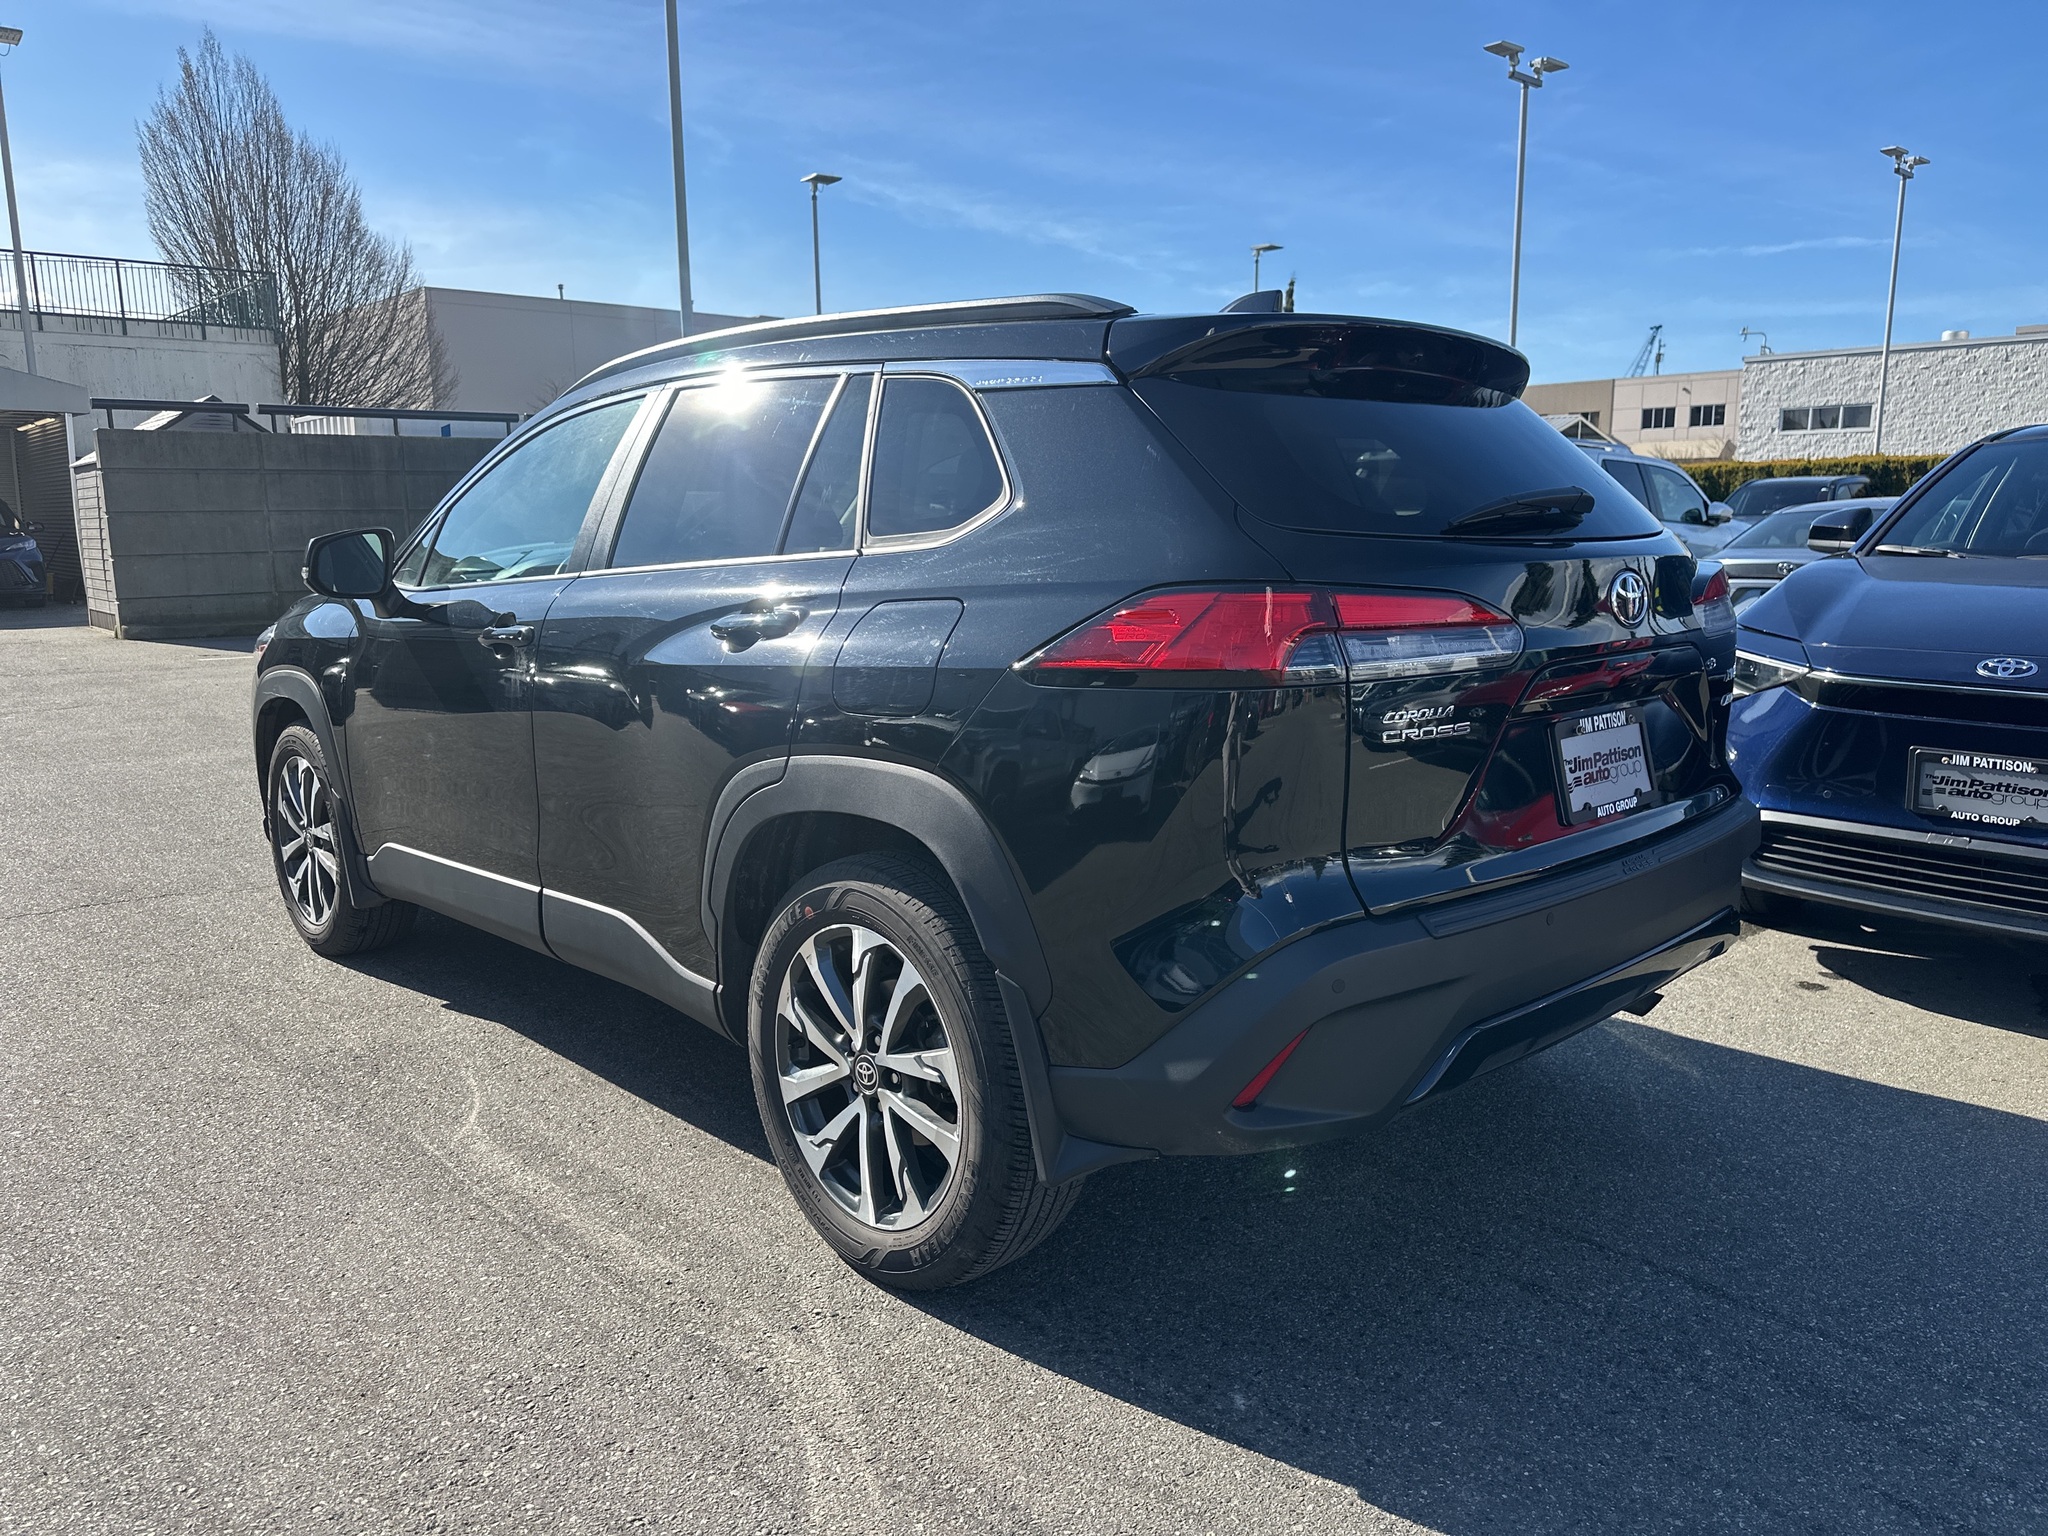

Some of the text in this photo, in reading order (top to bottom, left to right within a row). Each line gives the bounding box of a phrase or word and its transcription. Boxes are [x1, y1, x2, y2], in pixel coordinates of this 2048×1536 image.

[1382, 705, 1455, 724] COROLLA
[1593, 710, 1627, 731] PATTISON
[1382, 721, 1471, 744] CROSS
[1949, 754, 2032, 773] JIM PATTISON
[1597, 796, 1638, 818] AUTO GROUP
[1950, 811, 2021, 827] AUTO GROUP
[909, 1159, 979, 1267] GOODYEAR
